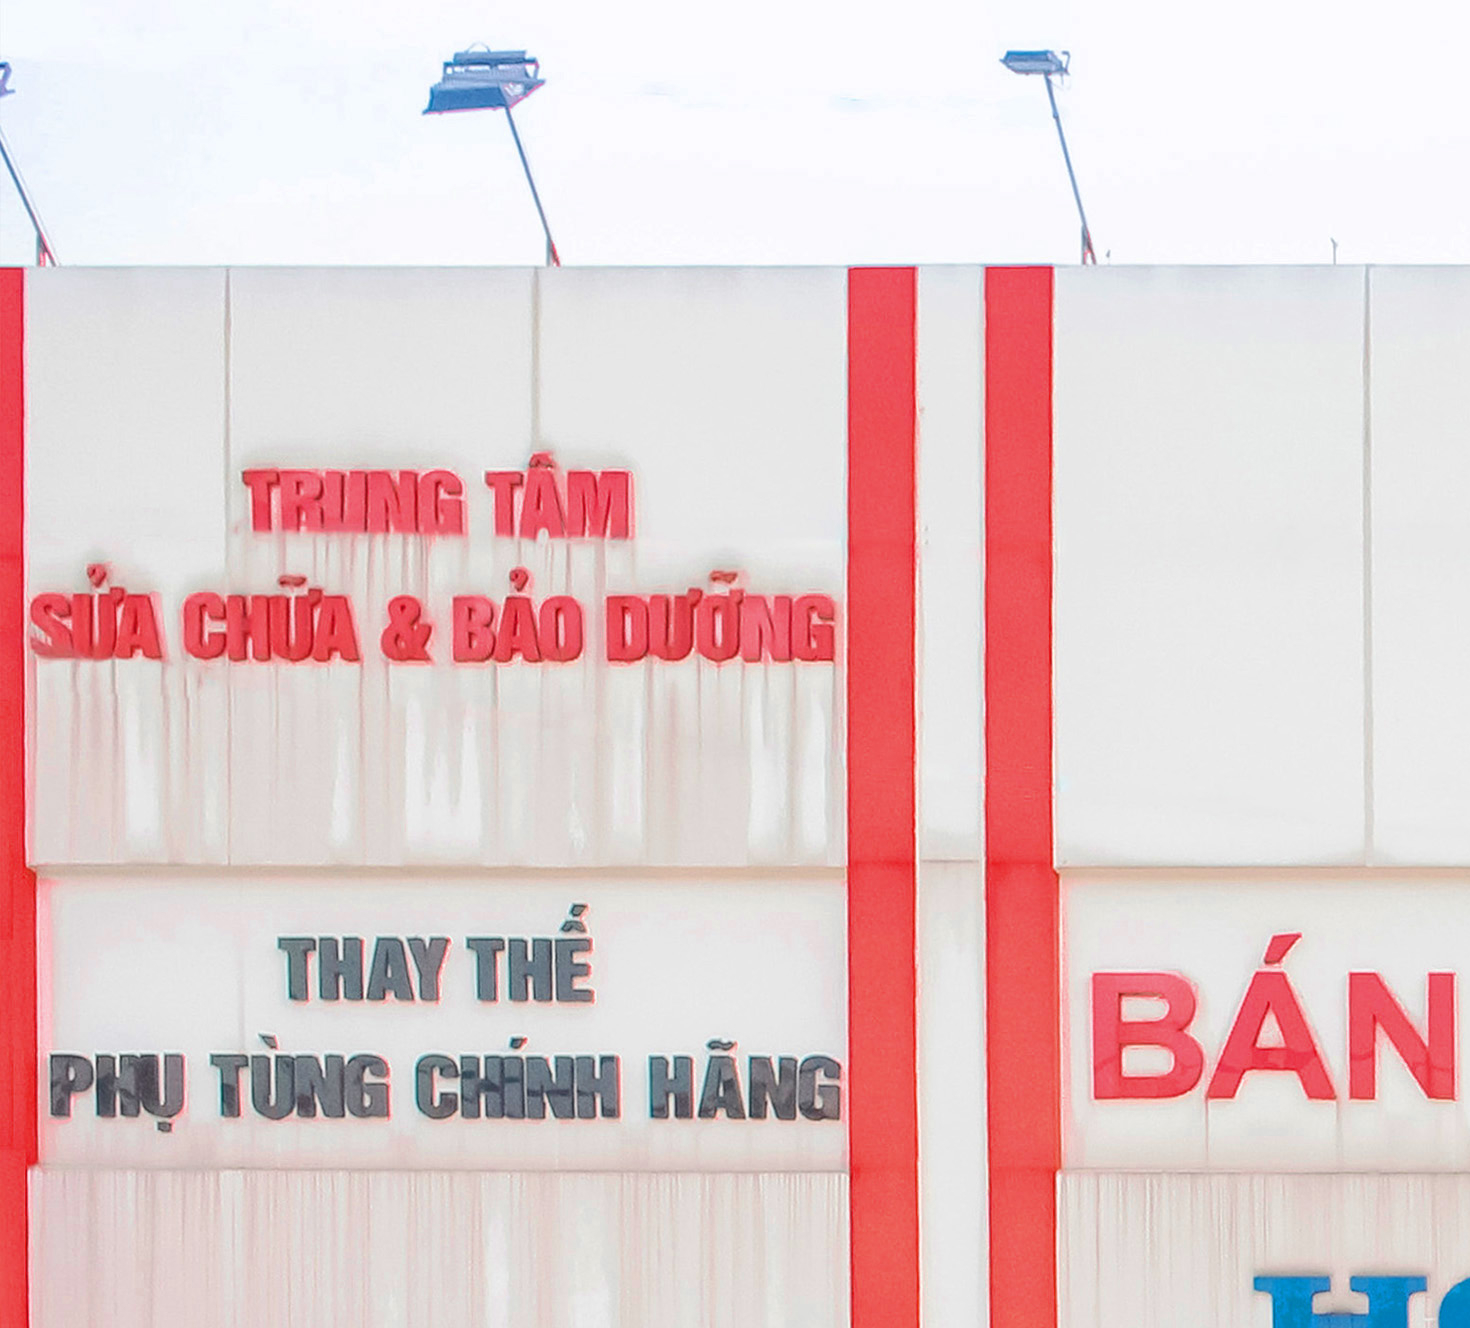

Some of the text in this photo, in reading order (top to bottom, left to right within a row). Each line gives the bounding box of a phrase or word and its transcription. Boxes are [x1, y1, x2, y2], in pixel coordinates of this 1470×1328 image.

[242, 452, 635, 540] TRUNG TÂM
[31, 563, 836, 664] SỬA CHỮA & BẢO DƯỠNG
[278, 904, 595, 1003] THAY THẾ
[1092, 932, 1458, 1101] BÁN
[49, 1034, 842, 1132] PHỤ TÙNG CHÍNH HÃNG
